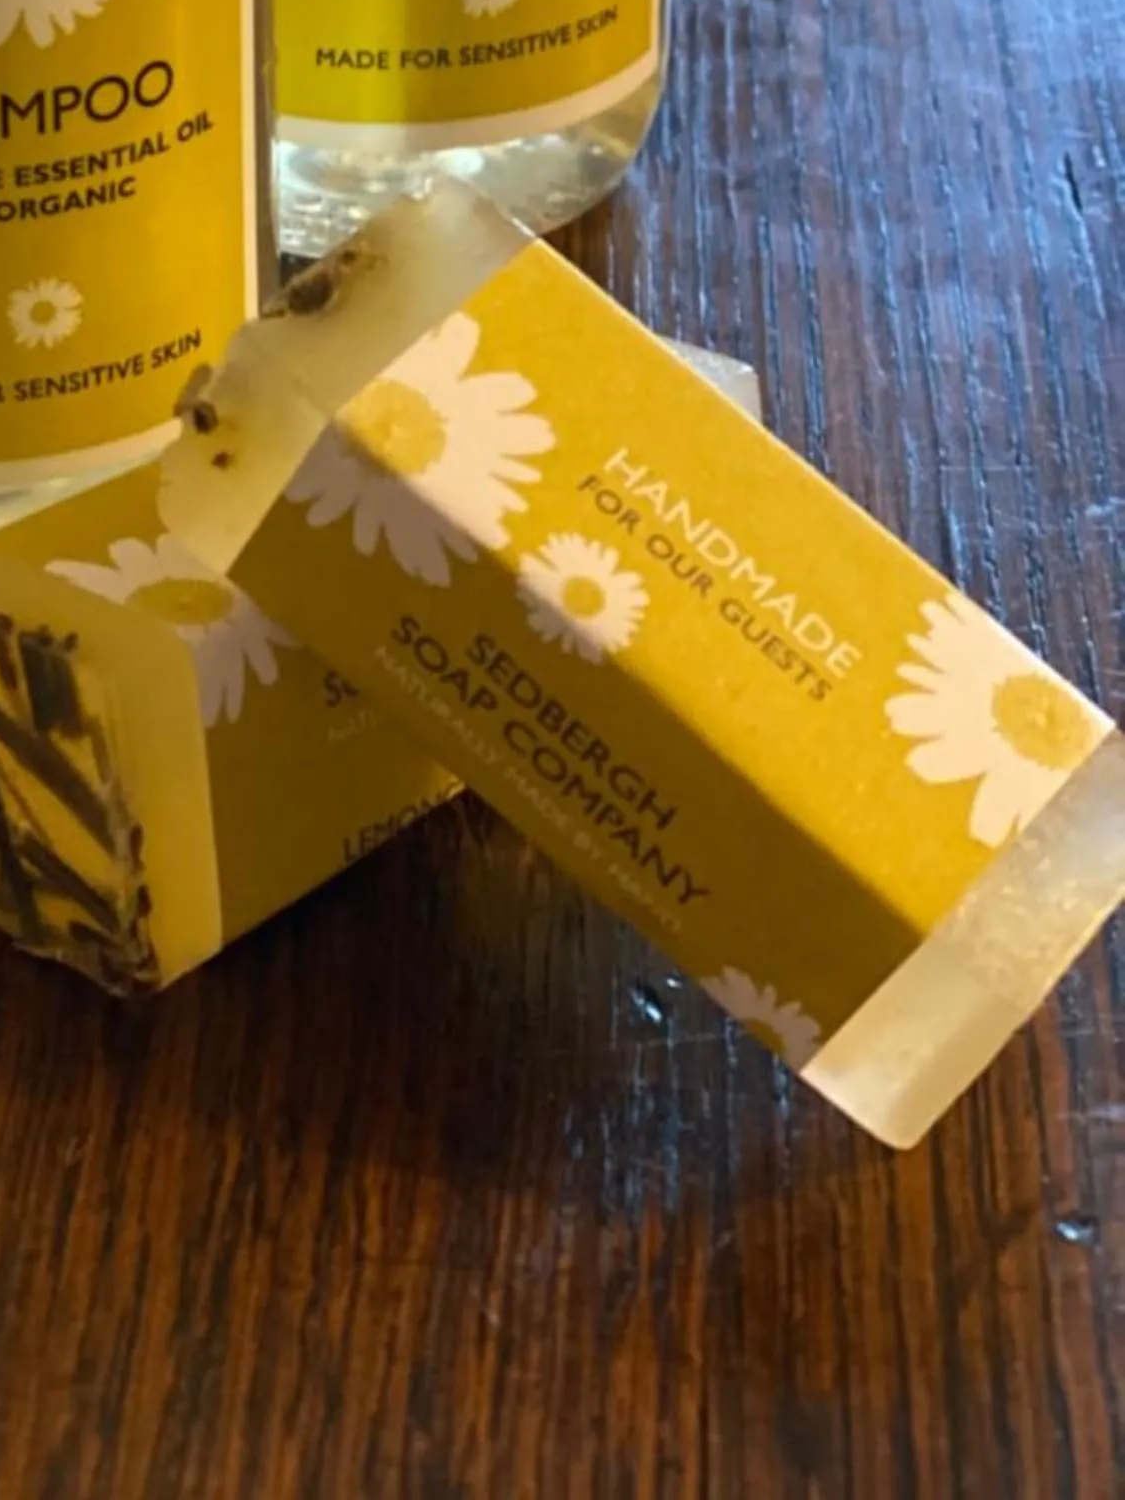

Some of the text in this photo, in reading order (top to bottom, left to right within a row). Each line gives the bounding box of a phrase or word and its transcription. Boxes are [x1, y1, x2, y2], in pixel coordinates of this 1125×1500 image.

[316, 5, 618, 70] MADE FOR SENSITIVE SKIN
[15, 132, 169, 187] ESSENTIAL
[176, 111, 213, 142] OIL
[13, 354, 145, 402] SENSITIVE
[151, 329, 202, 370] SKIN
[578, 474, 833, 701] FOR OUR GUESTS
[603, 447, 863, 679] HANDMADE
[391, 615, 710, 904] SOAP COMPANY
[466, 633, 677, 831] SEDBERGH
